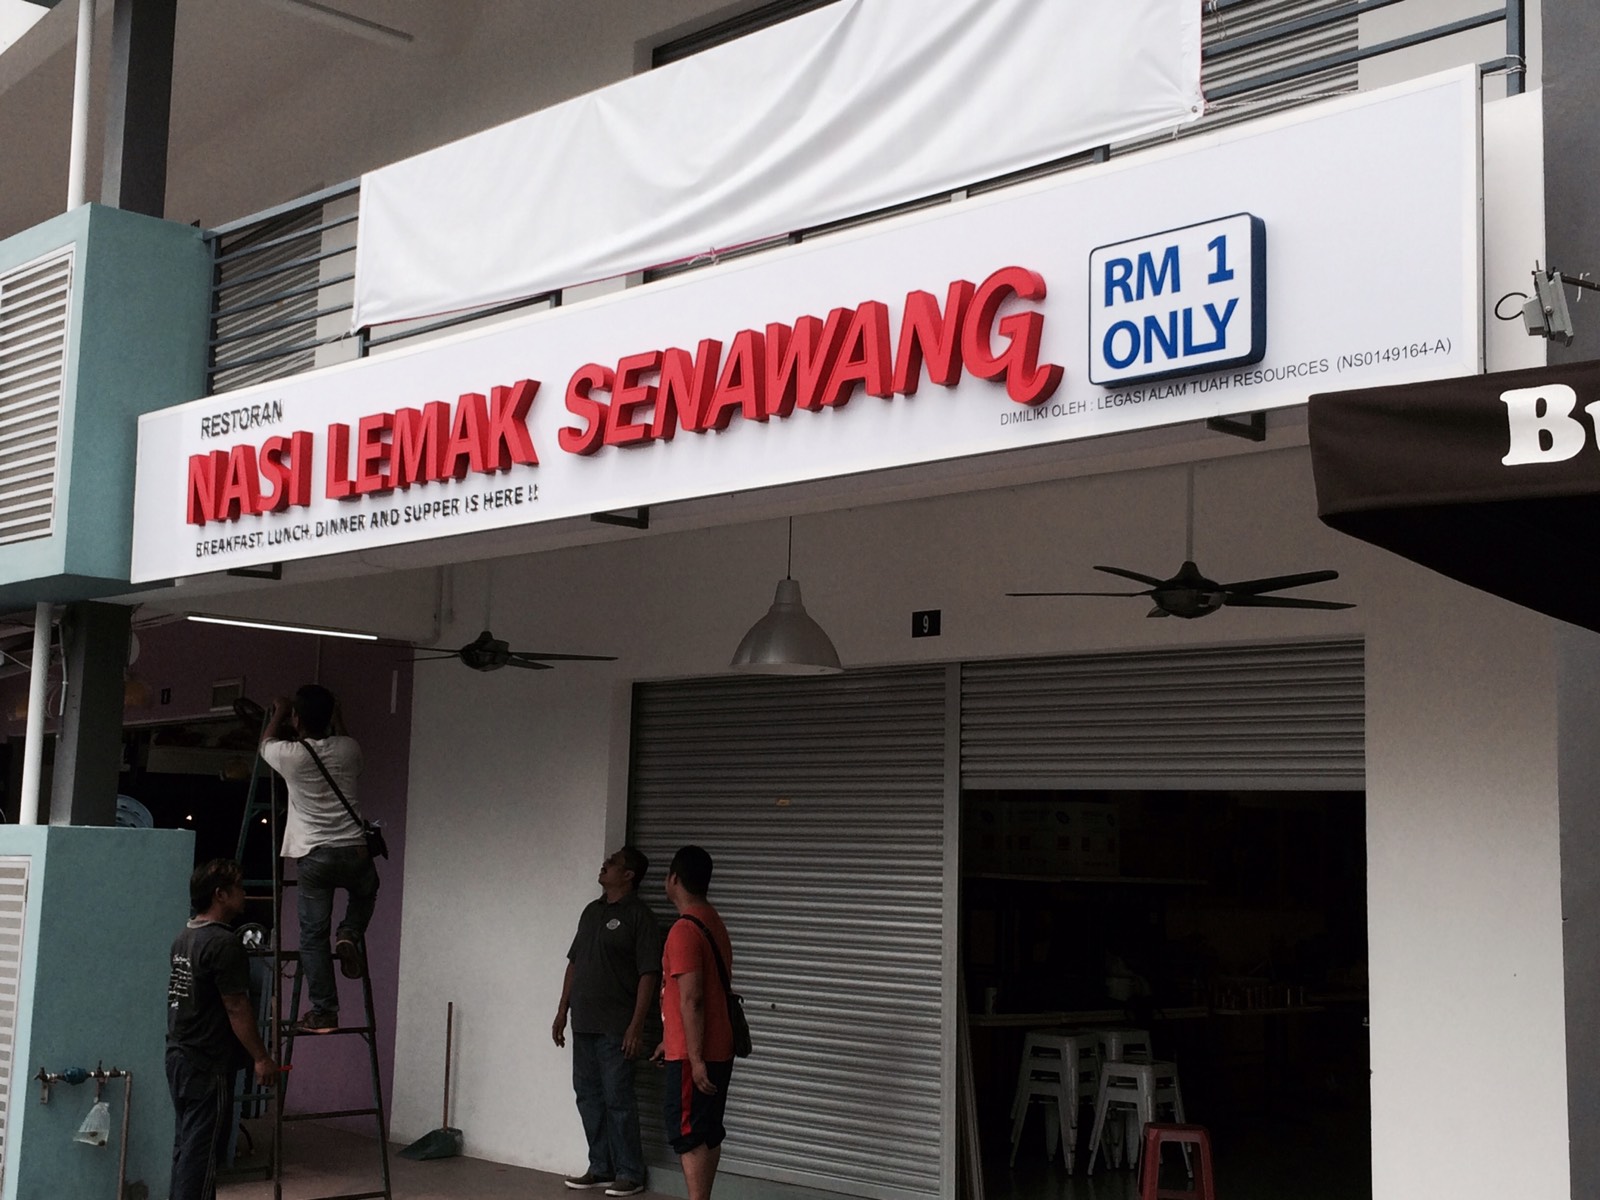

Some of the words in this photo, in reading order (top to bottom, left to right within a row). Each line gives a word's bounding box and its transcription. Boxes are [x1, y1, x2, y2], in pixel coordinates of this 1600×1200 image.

[1104, 245, 1180, 307] RM
[1207, 234, 1234, 285] 1
[1102, 298, 1240, 370] ONLY
[187, 430, 314, 526] NASI
[326, 378, 542, 500] LEMAK
[557, 266, 1064, 456] SENAWANG
[1000, 406, 1048, 426] DIMILIKI
[1051, 400, 1087, 417] OLEH
[1097, 389, 1146, 410] LEGASI
[1148, 383, 1187, 402] ALAM
[1190, 376, 1229, 394] TUAH
[1233, 358, 1329, 388] RESOURCES
[1336, 337, 1452, 373] (NS0149164-A)
[201, 400, 283, 439] RESTORAN
[315, 514, 365, 538] DINNER
[370, 508, 400, 528] AND
[404, 498, 460, 524] SUPPER
[465, 494, 479, 513] IS
[483, 486, 523, 511] HERE
[922, 614, 929, 634] 9
